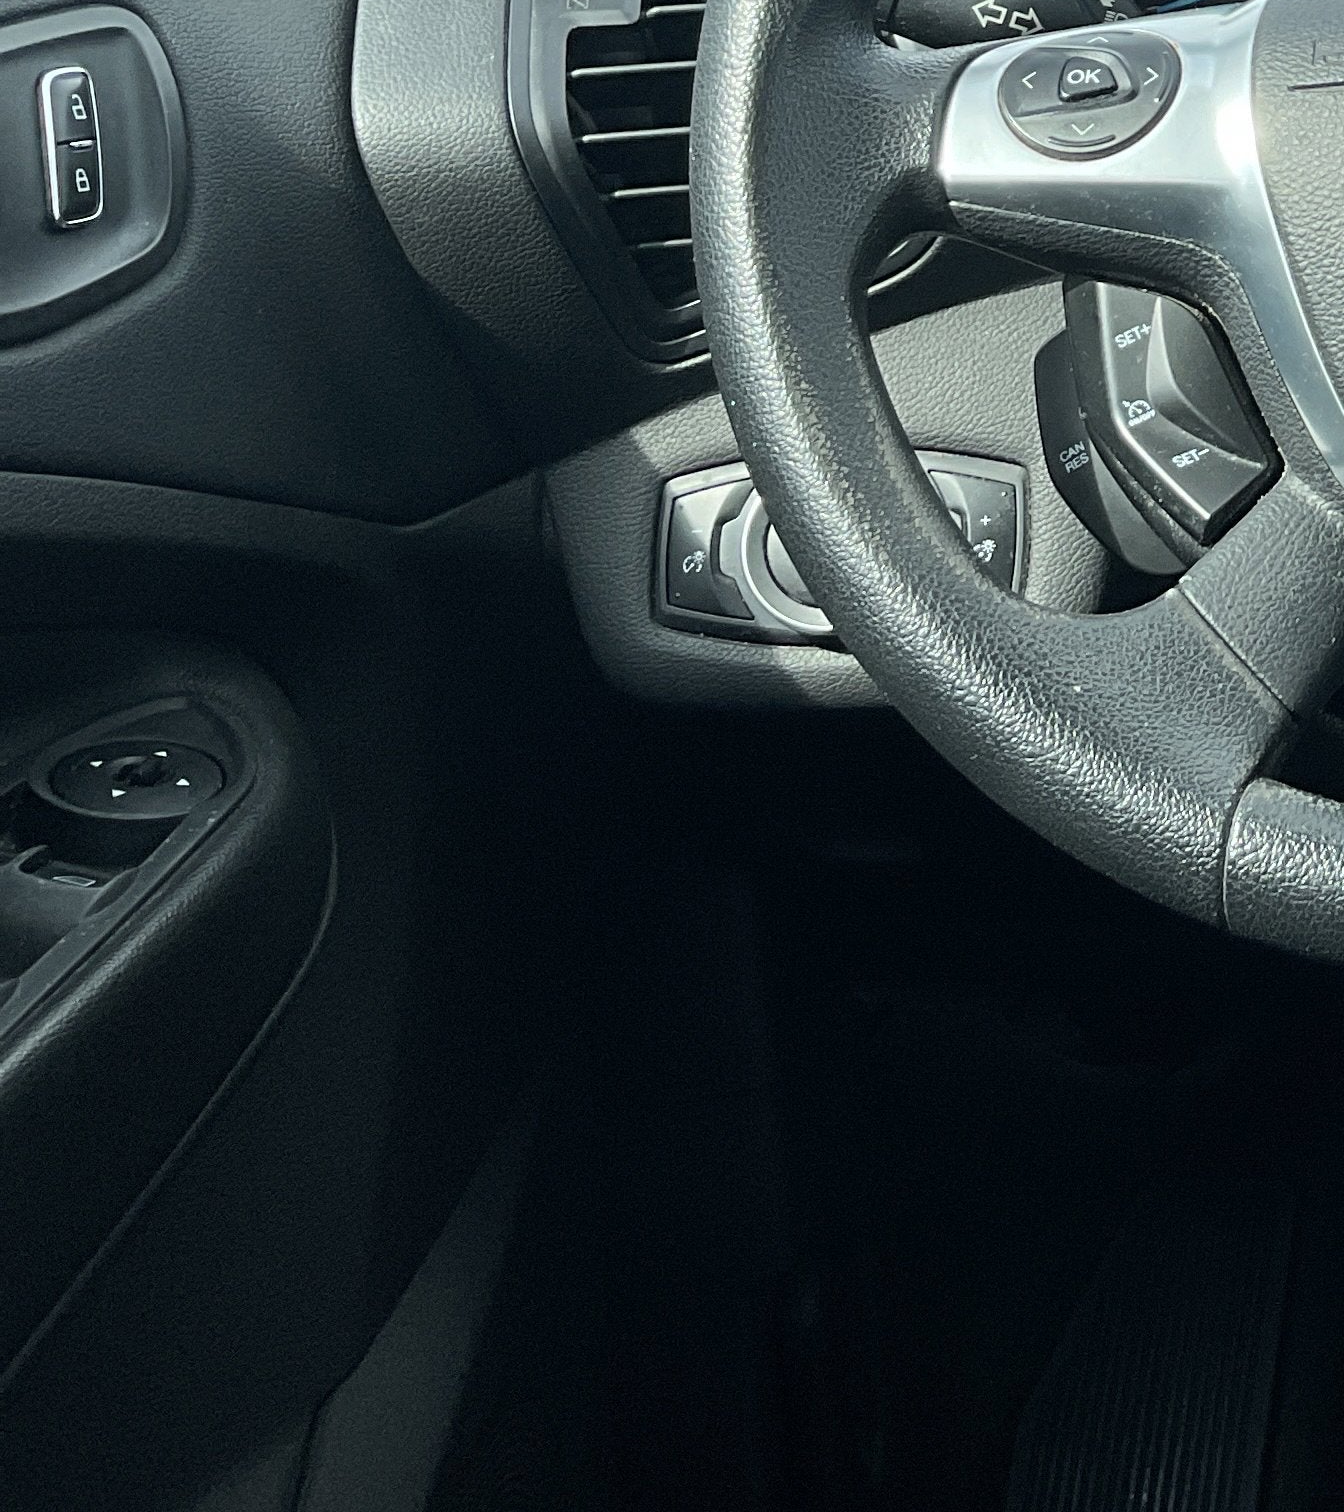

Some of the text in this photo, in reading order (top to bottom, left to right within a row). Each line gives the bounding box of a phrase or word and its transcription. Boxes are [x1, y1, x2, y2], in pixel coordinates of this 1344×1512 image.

[1066, 68, 1102, 85] OK
[1114, 323, 1152, 349] SET+
[1059, 440, 1086, 464] CAN
[1064, 452, 1091, 474] RES
